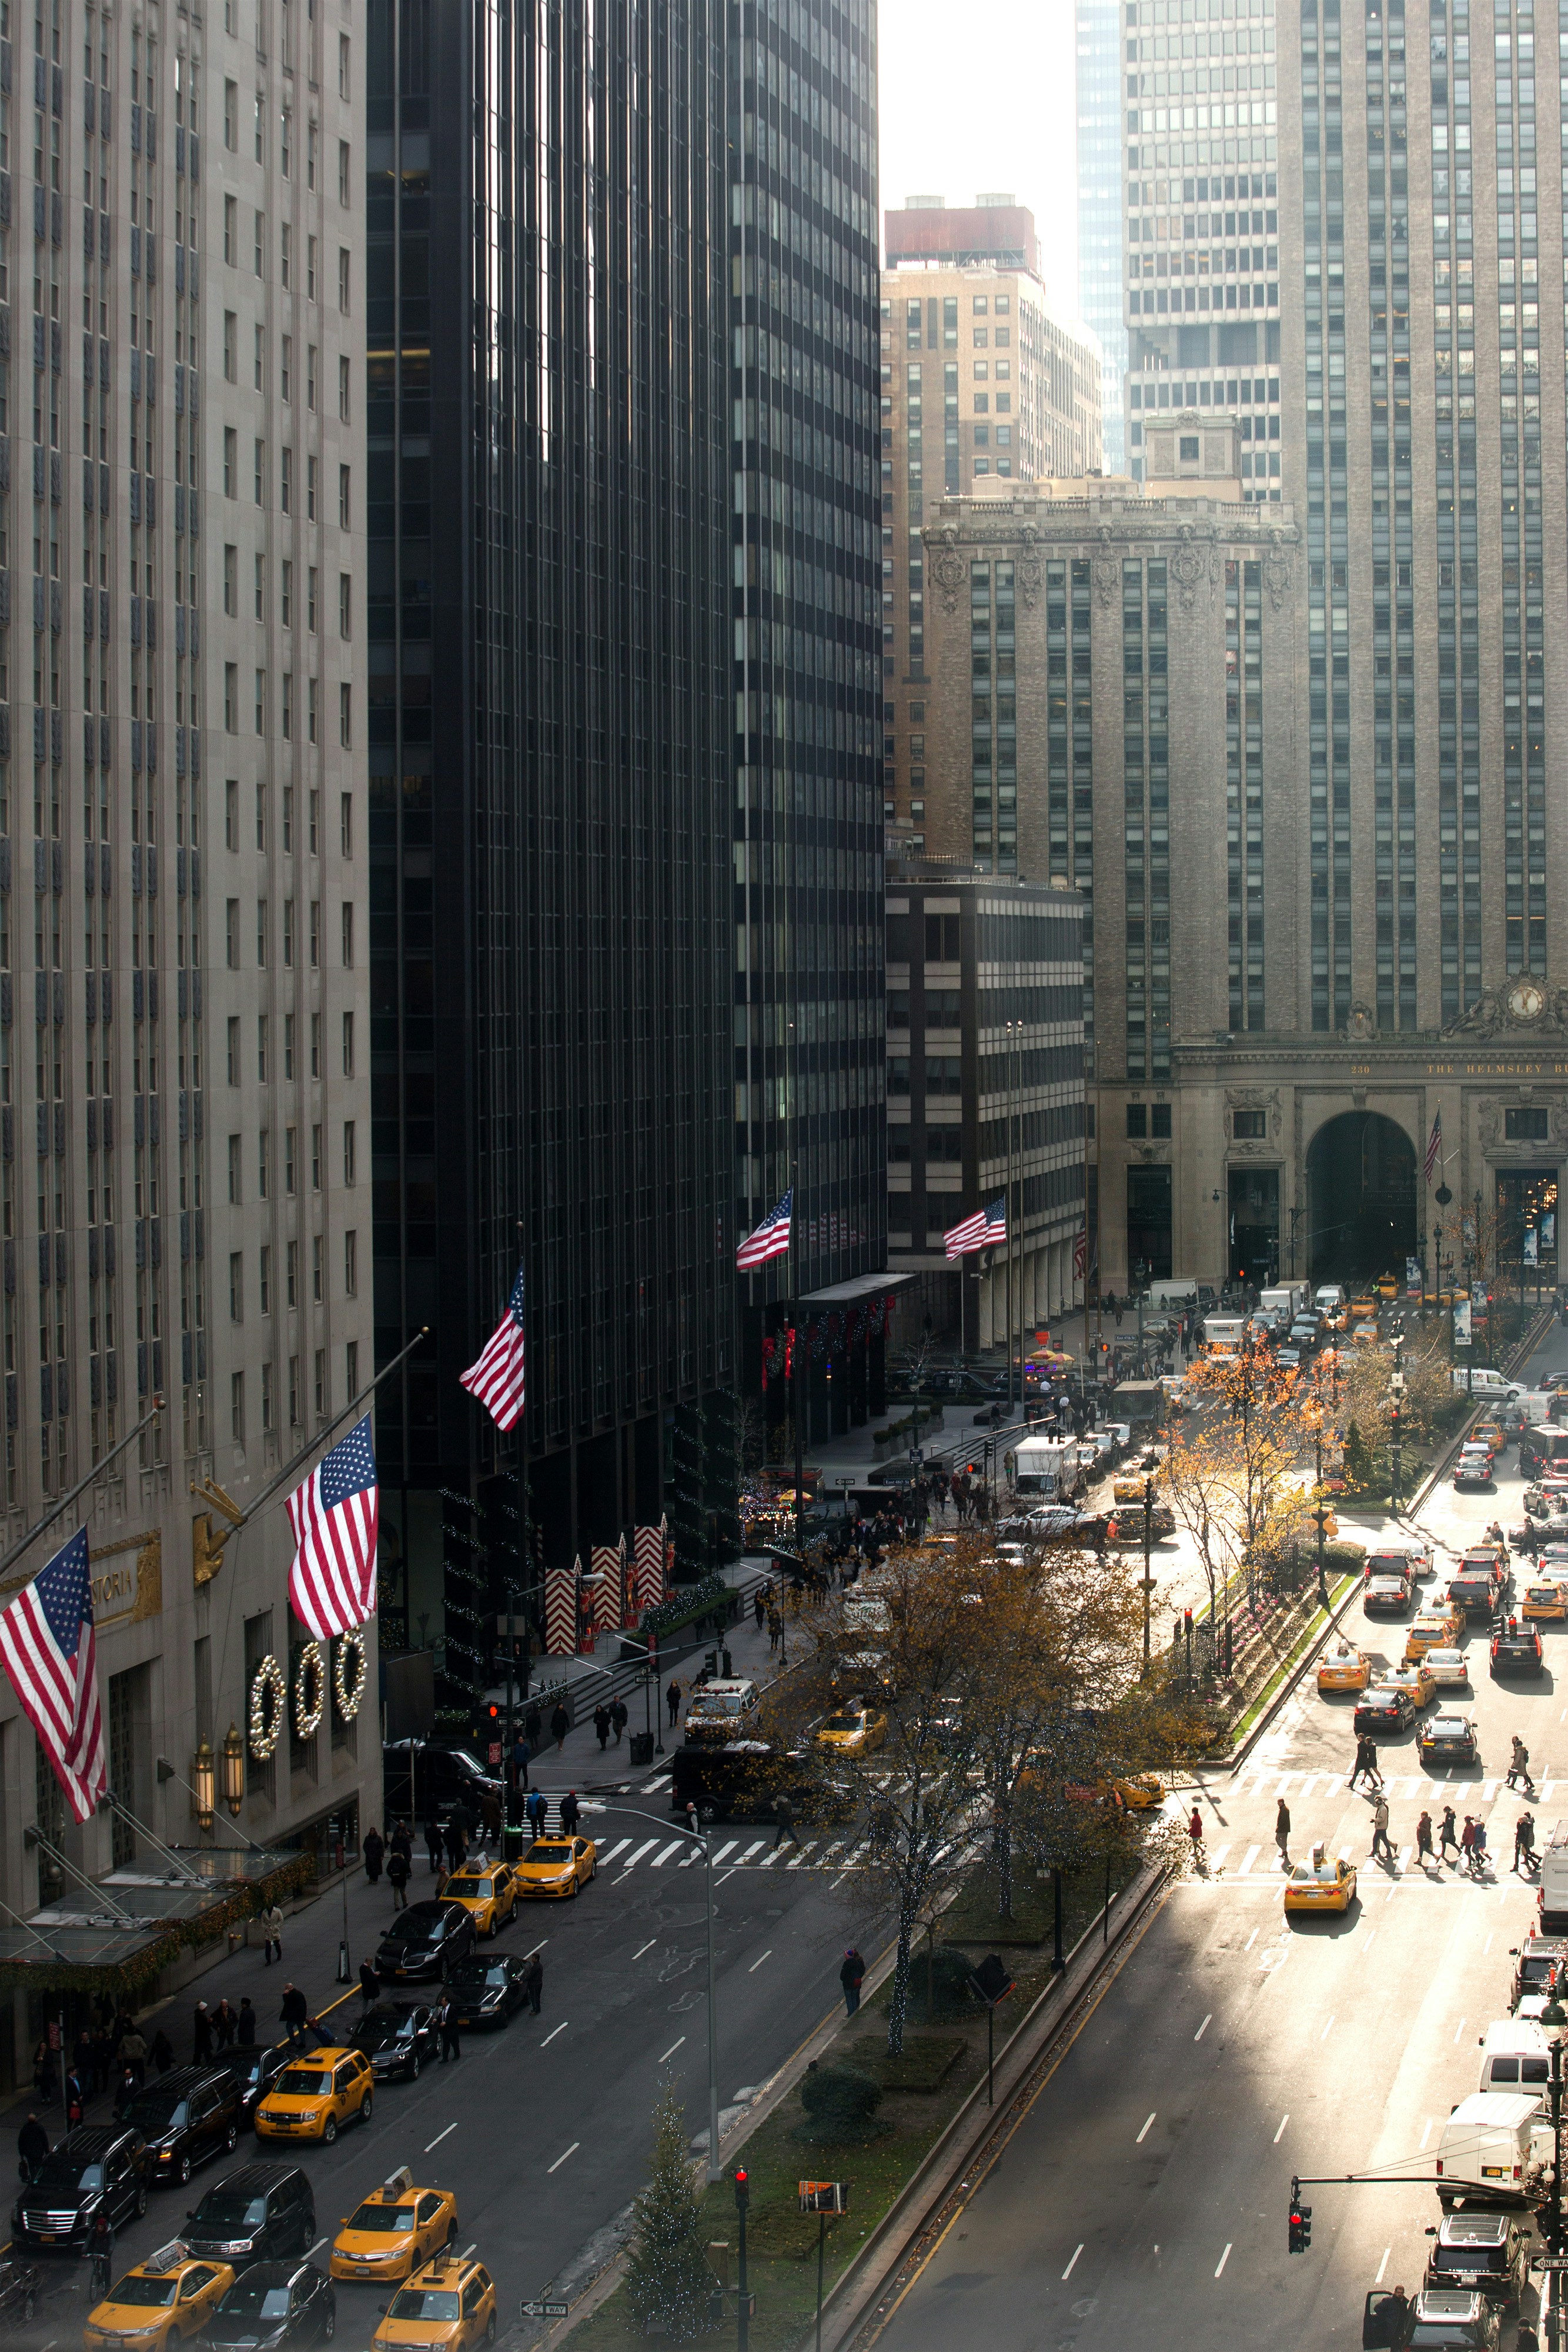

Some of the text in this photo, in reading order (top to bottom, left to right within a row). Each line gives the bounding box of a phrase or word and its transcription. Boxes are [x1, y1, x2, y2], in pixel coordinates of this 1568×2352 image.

[1352, 1065, 1370, 1074] 230
[1427, 1065, 1455, 1074] THE
[1467, 1065, 1542, 1073] HELMSLEY
